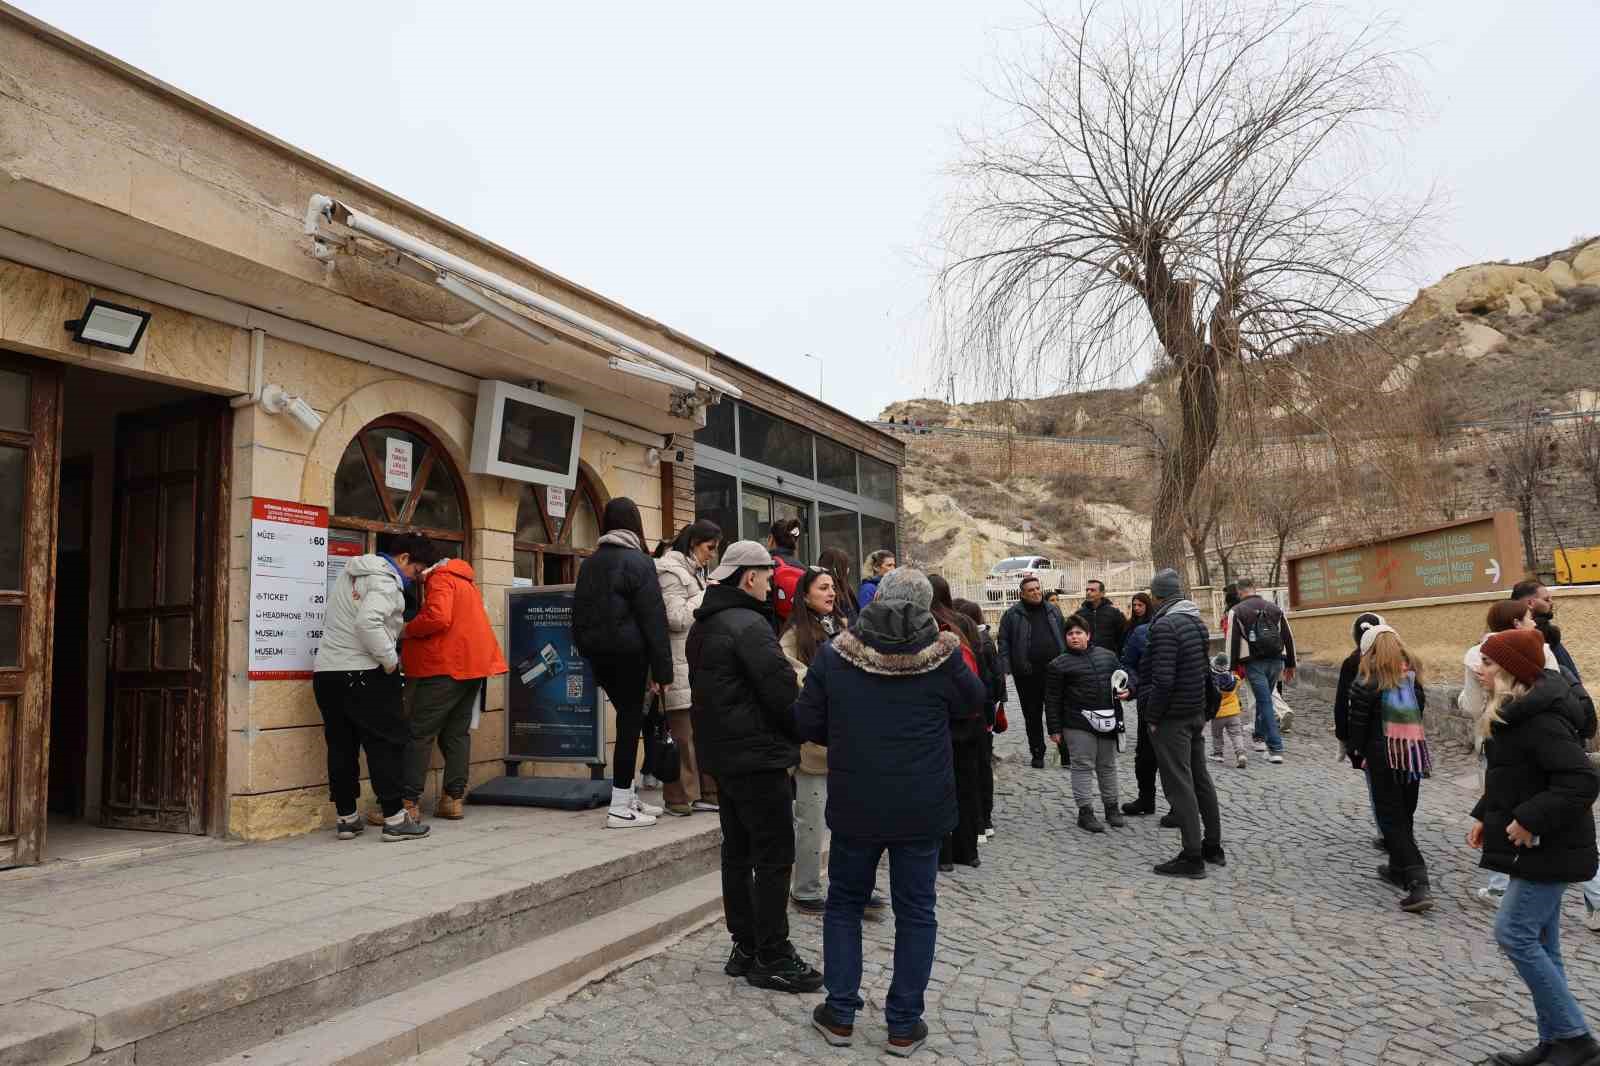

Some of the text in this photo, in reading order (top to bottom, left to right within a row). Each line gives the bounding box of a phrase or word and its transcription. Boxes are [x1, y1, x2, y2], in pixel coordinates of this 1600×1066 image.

[263, 593, 288, 602] TICKET
[263, 611, 302, 620] HEADPHONE
[255, 629, 284, 638] MUSEUM
[254, 647, 283, 656] MUSEUM
